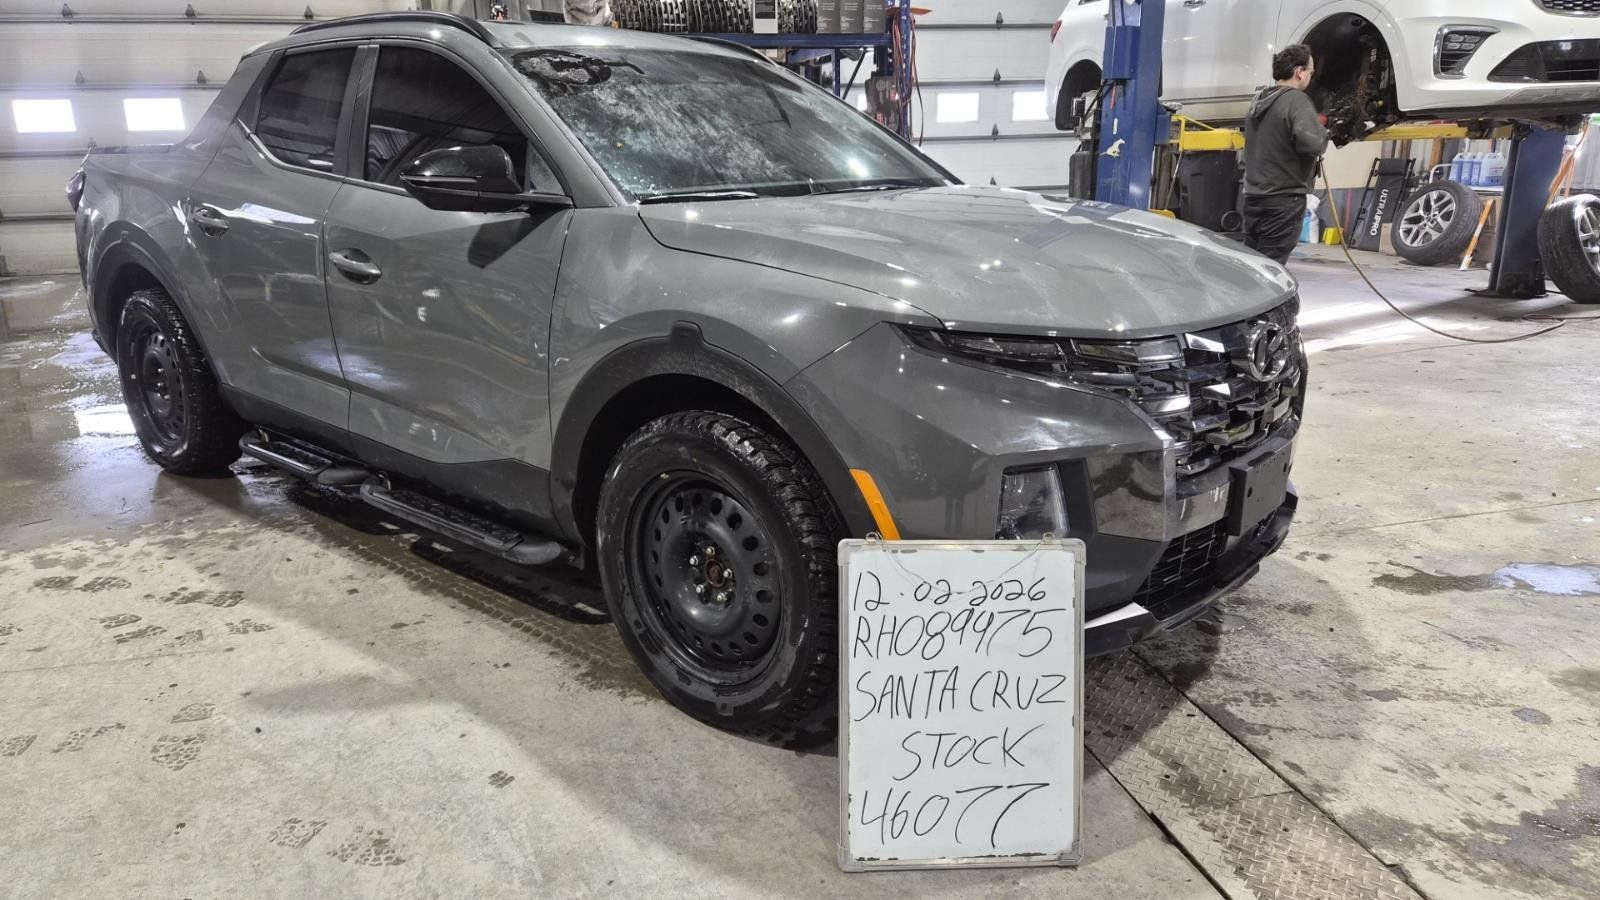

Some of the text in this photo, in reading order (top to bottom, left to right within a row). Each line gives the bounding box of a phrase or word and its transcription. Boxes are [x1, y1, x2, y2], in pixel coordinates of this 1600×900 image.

[1370, 188, 1389, 236] ULTRAPRO
[854, 665, 1066, 721] SANTA CRUZ
[892, 724, 1045, 781] STOCK
[861, 783, 1050, 849] 46077
